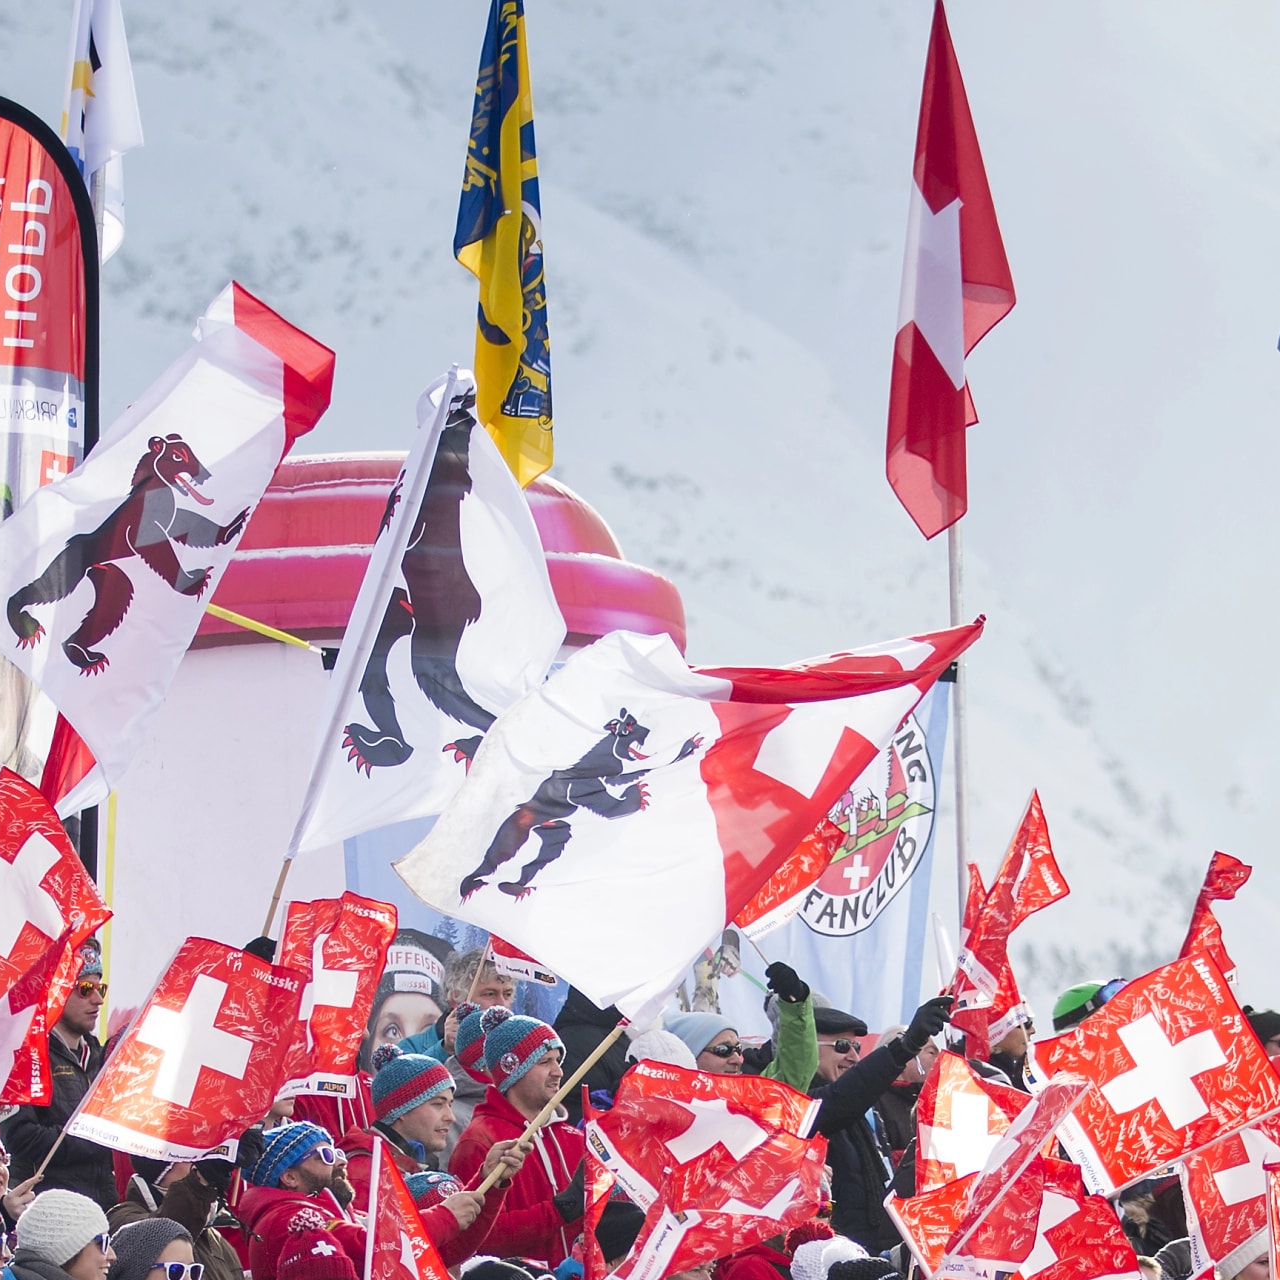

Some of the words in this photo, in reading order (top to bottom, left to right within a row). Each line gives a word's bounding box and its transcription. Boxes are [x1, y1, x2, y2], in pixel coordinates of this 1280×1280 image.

[801, 826, 918, 930] FANCLUB
[343, 902, 391, 924] swissski
[251, 967, 300, 993] swissski
[30, 1047, 45, 1099] swissski
[323, 1082, 347, 1094] ALPIQ
[79, 1123, 120, 1143] swisscom
